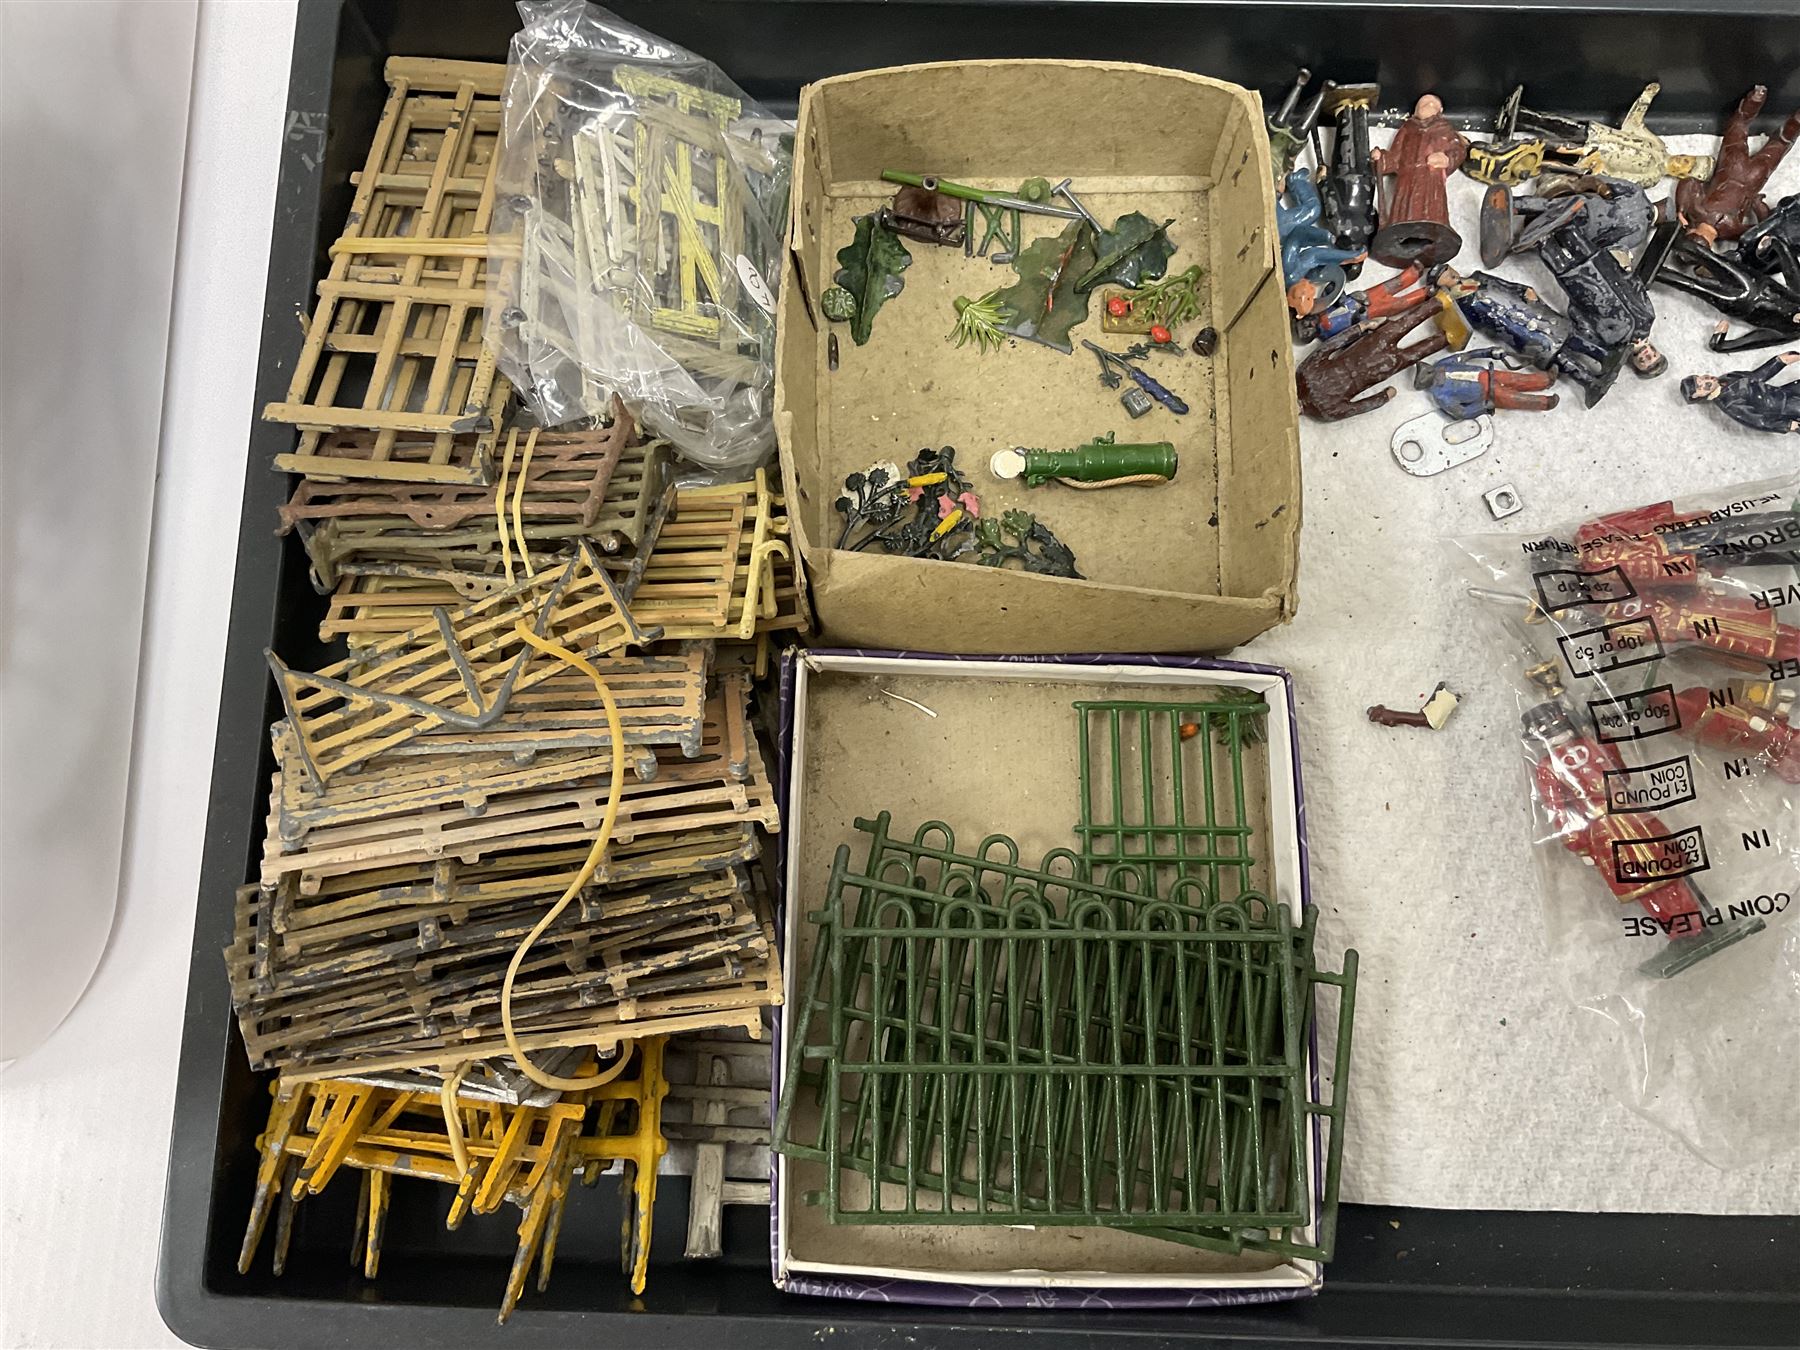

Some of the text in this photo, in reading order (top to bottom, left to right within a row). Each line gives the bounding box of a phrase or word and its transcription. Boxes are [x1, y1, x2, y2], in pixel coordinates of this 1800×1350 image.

[1653, 521, 1688, 535] BAG
[1700, 521, 1800, 558] BRONZE
[1662, 561, 1692, 577] IN
[1594, 582, 1613, 592] 2p
[1750, 583, 1800, 610] VER
[1693, 617, 1720, 639] IN
[1598, 643, 1614, 653] or
[1617, 635, 1645, 649] 10p
[1709, 687, 1735, 709] IN
[1600, 713, 1623, 728] 20p
[1644, 703, 1670, 717] 50p
[1614, 758, 1751, 804] IN £1 POUND
[1650, 765, 1685, 786] COIN
[1622, 829, 1771, 875] IN £2 POUND
[1663, 835, 1697, 856] COIN
[1622, 892, 1791, 937] COIN PLEASE
